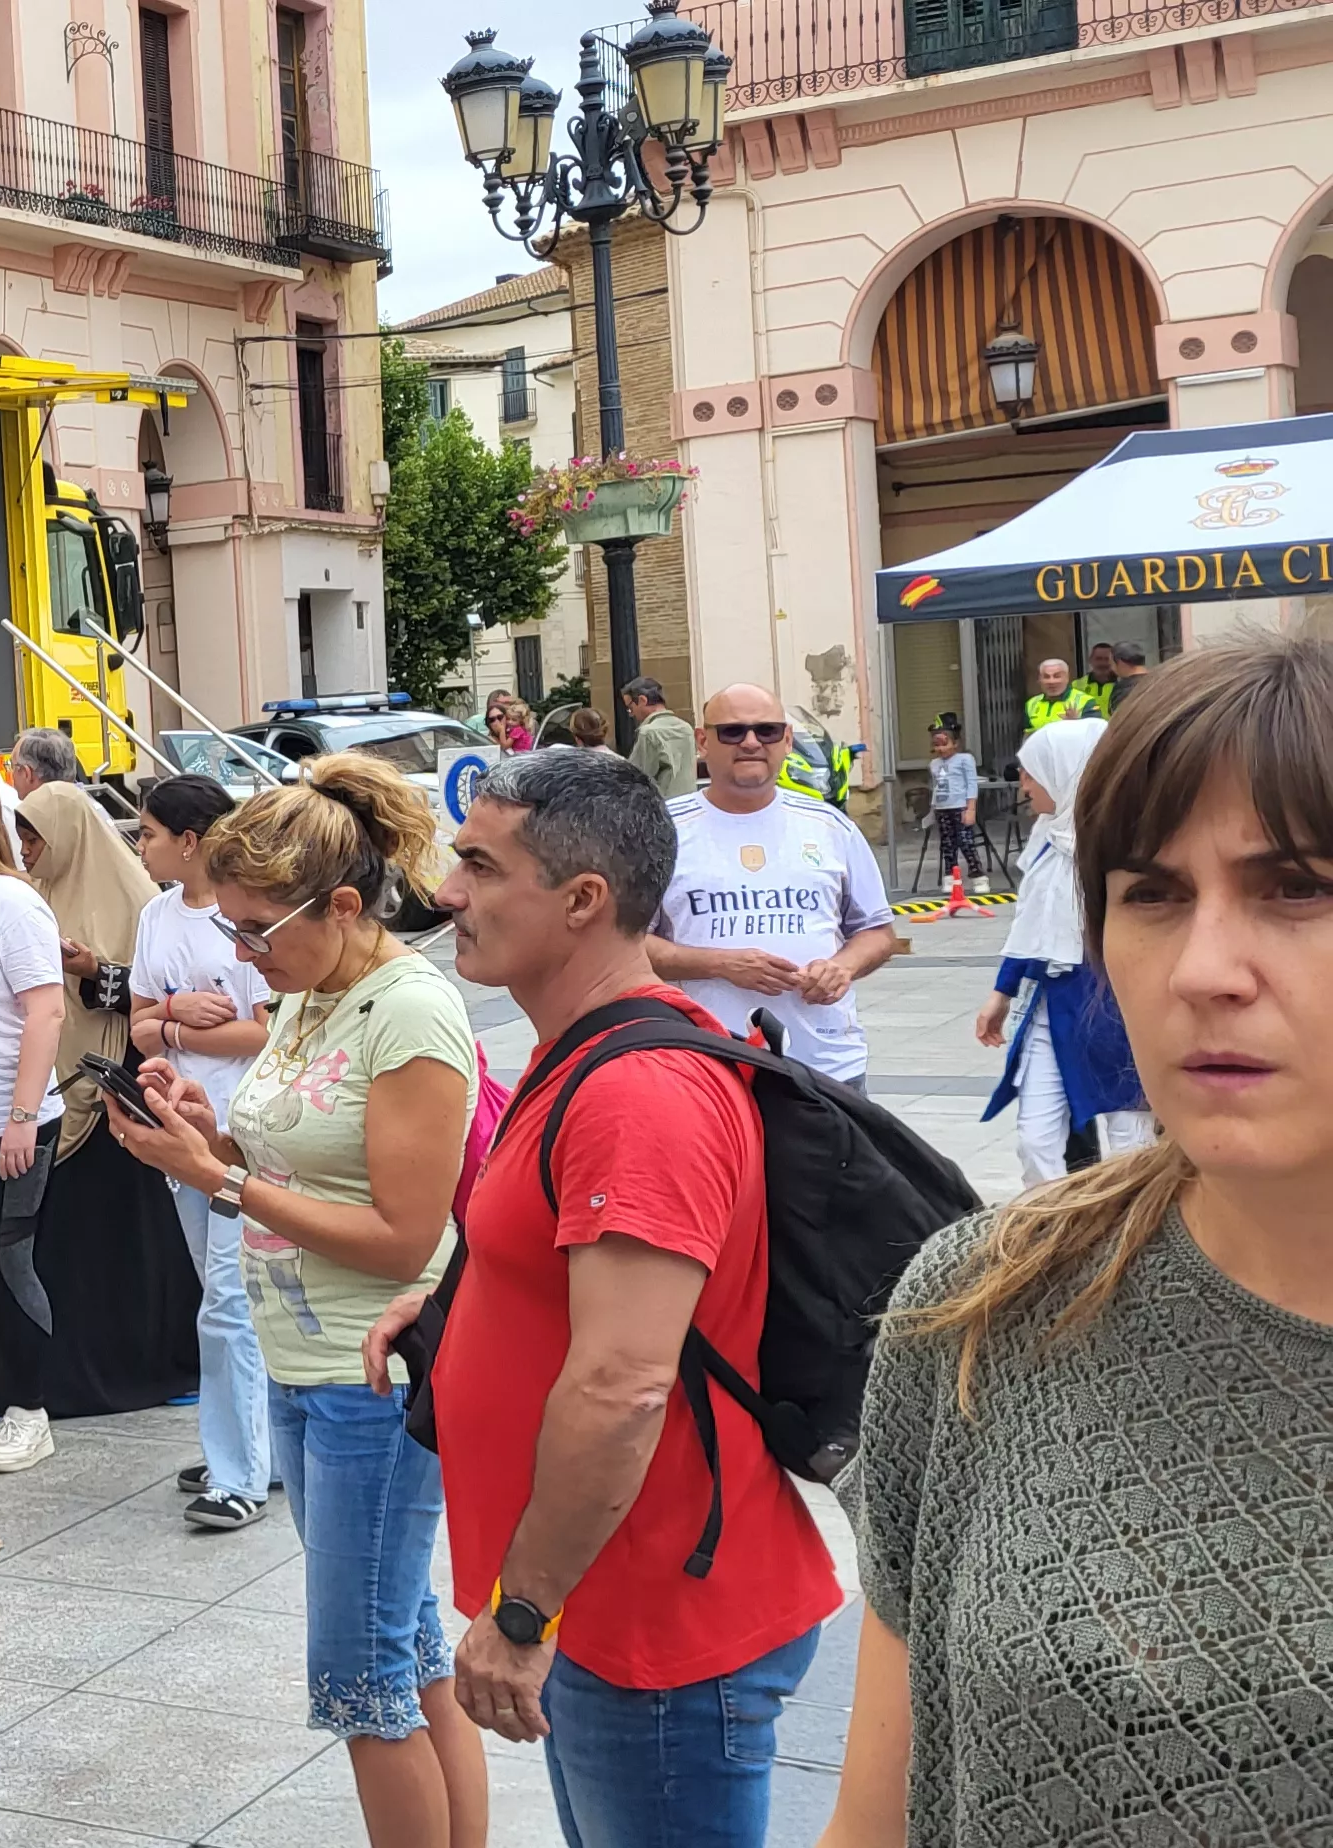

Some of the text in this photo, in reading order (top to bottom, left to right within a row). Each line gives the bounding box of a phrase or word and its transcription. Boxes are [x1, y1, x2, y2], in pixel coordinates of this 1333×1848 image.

[1035, 550, 1265, 603] GUARDIA
[685, 884, 820, 916] Emirates
[710, 913, 806, 940] FLY BETTER
